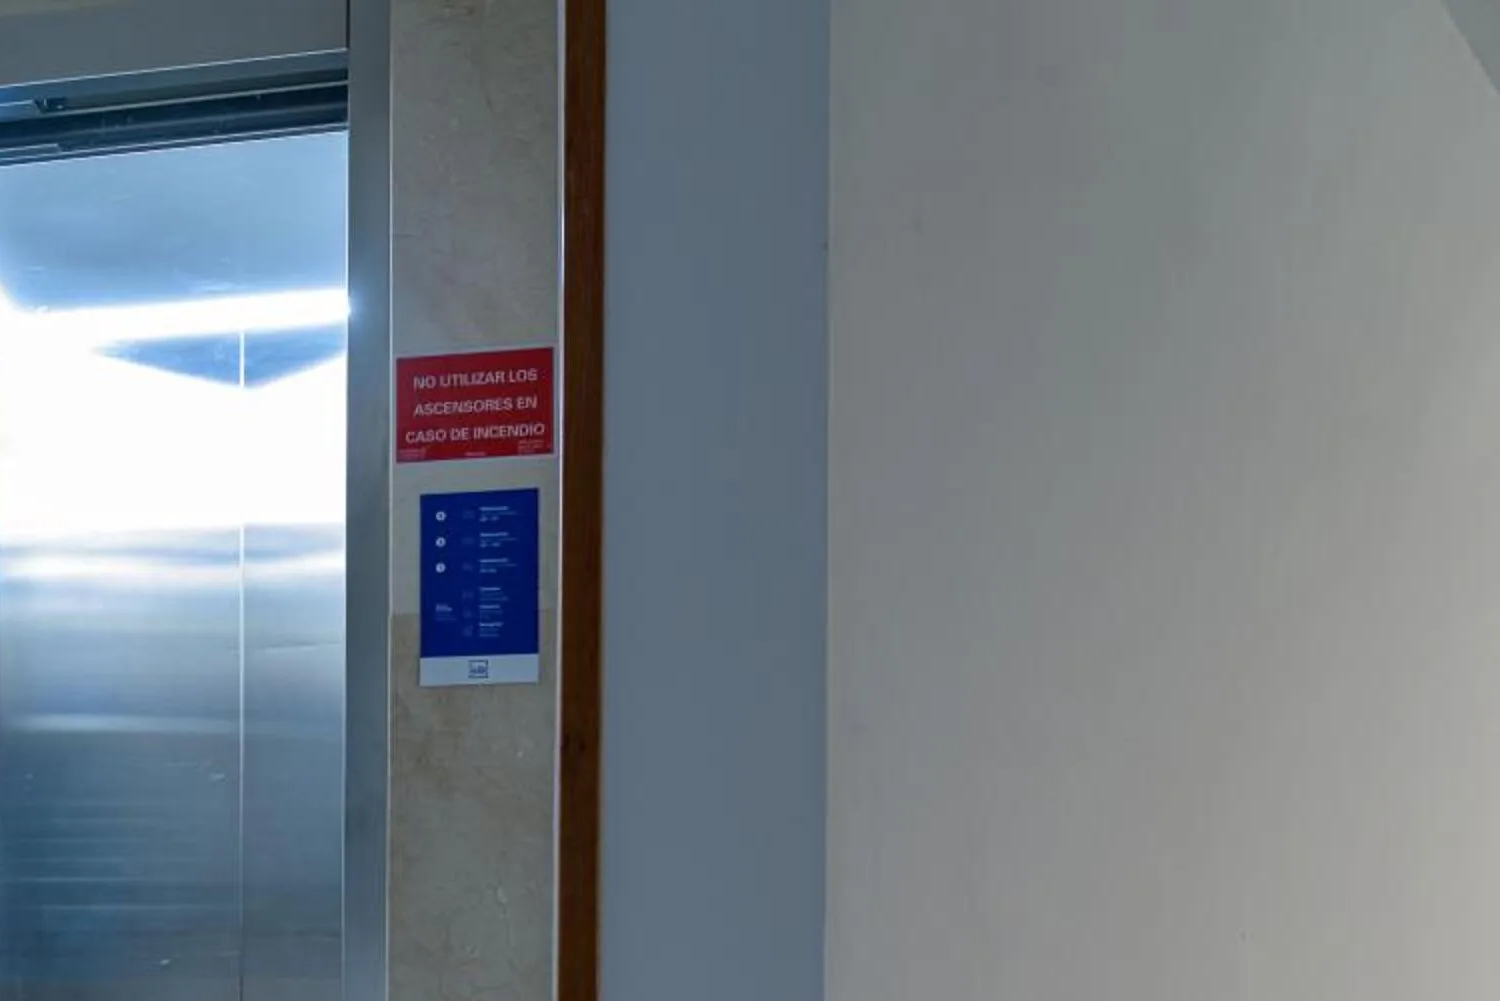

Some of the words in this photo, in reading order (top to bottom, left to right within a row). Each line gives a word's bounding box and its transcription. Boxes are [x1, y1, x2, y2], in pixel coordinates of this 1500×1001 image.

[413, 375, 436, 390] NO
[439, 370, 505, 388] UTILIZAR
[509, 367, 538, 383] LOS
[414, 398, 513, 416] ASCENSORES
[516, 396, 538, 409] EN
[405, 429, 447, 443] CASO
[450, 427, 470, 441] DE
[473, 423, 545, 439] INCENDIO
